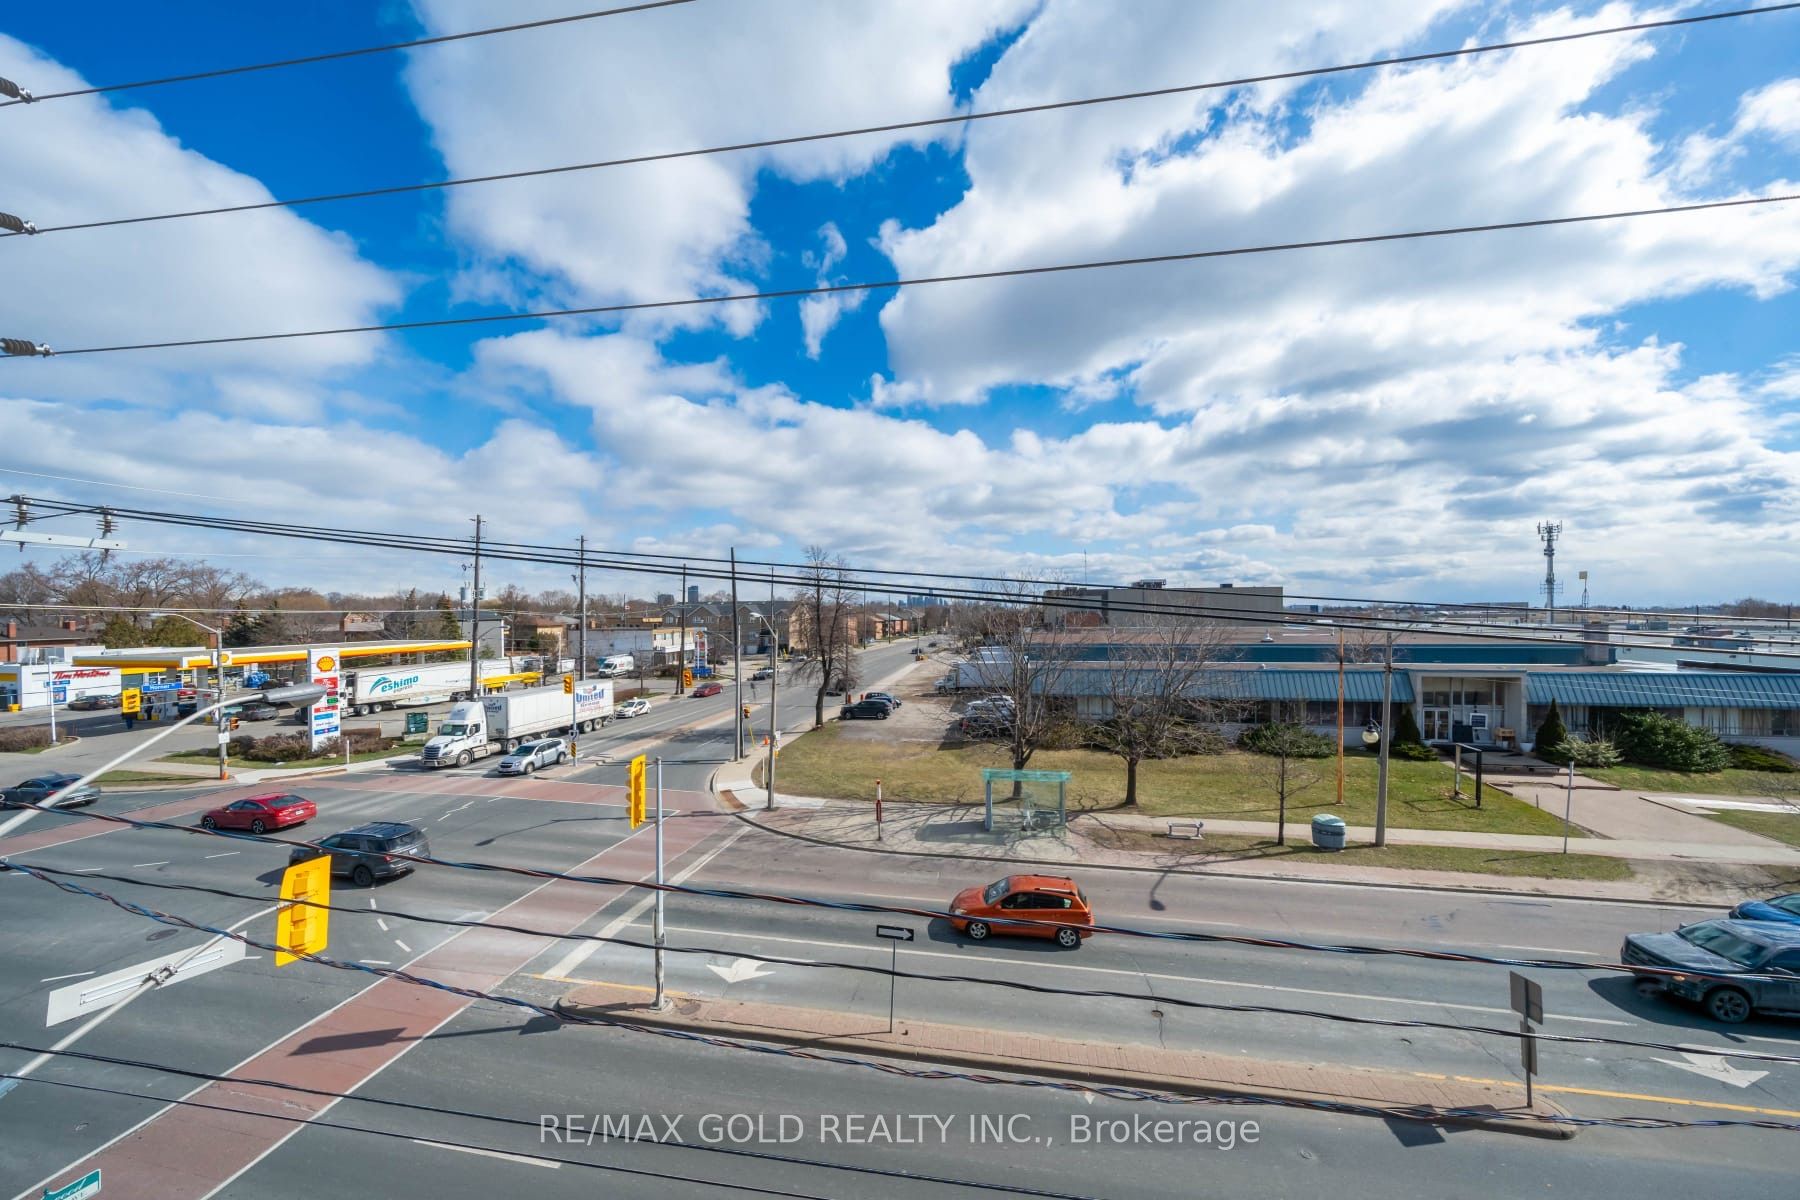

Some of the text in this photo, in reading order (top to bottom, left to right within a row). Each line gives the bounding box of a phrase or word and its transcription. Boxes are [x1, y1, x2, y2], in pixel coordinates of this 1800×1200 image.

[72, 669, 111, 679] Hortons
[381, 674, 419, 693] eskimo
[575, 688, 604, 703] United
